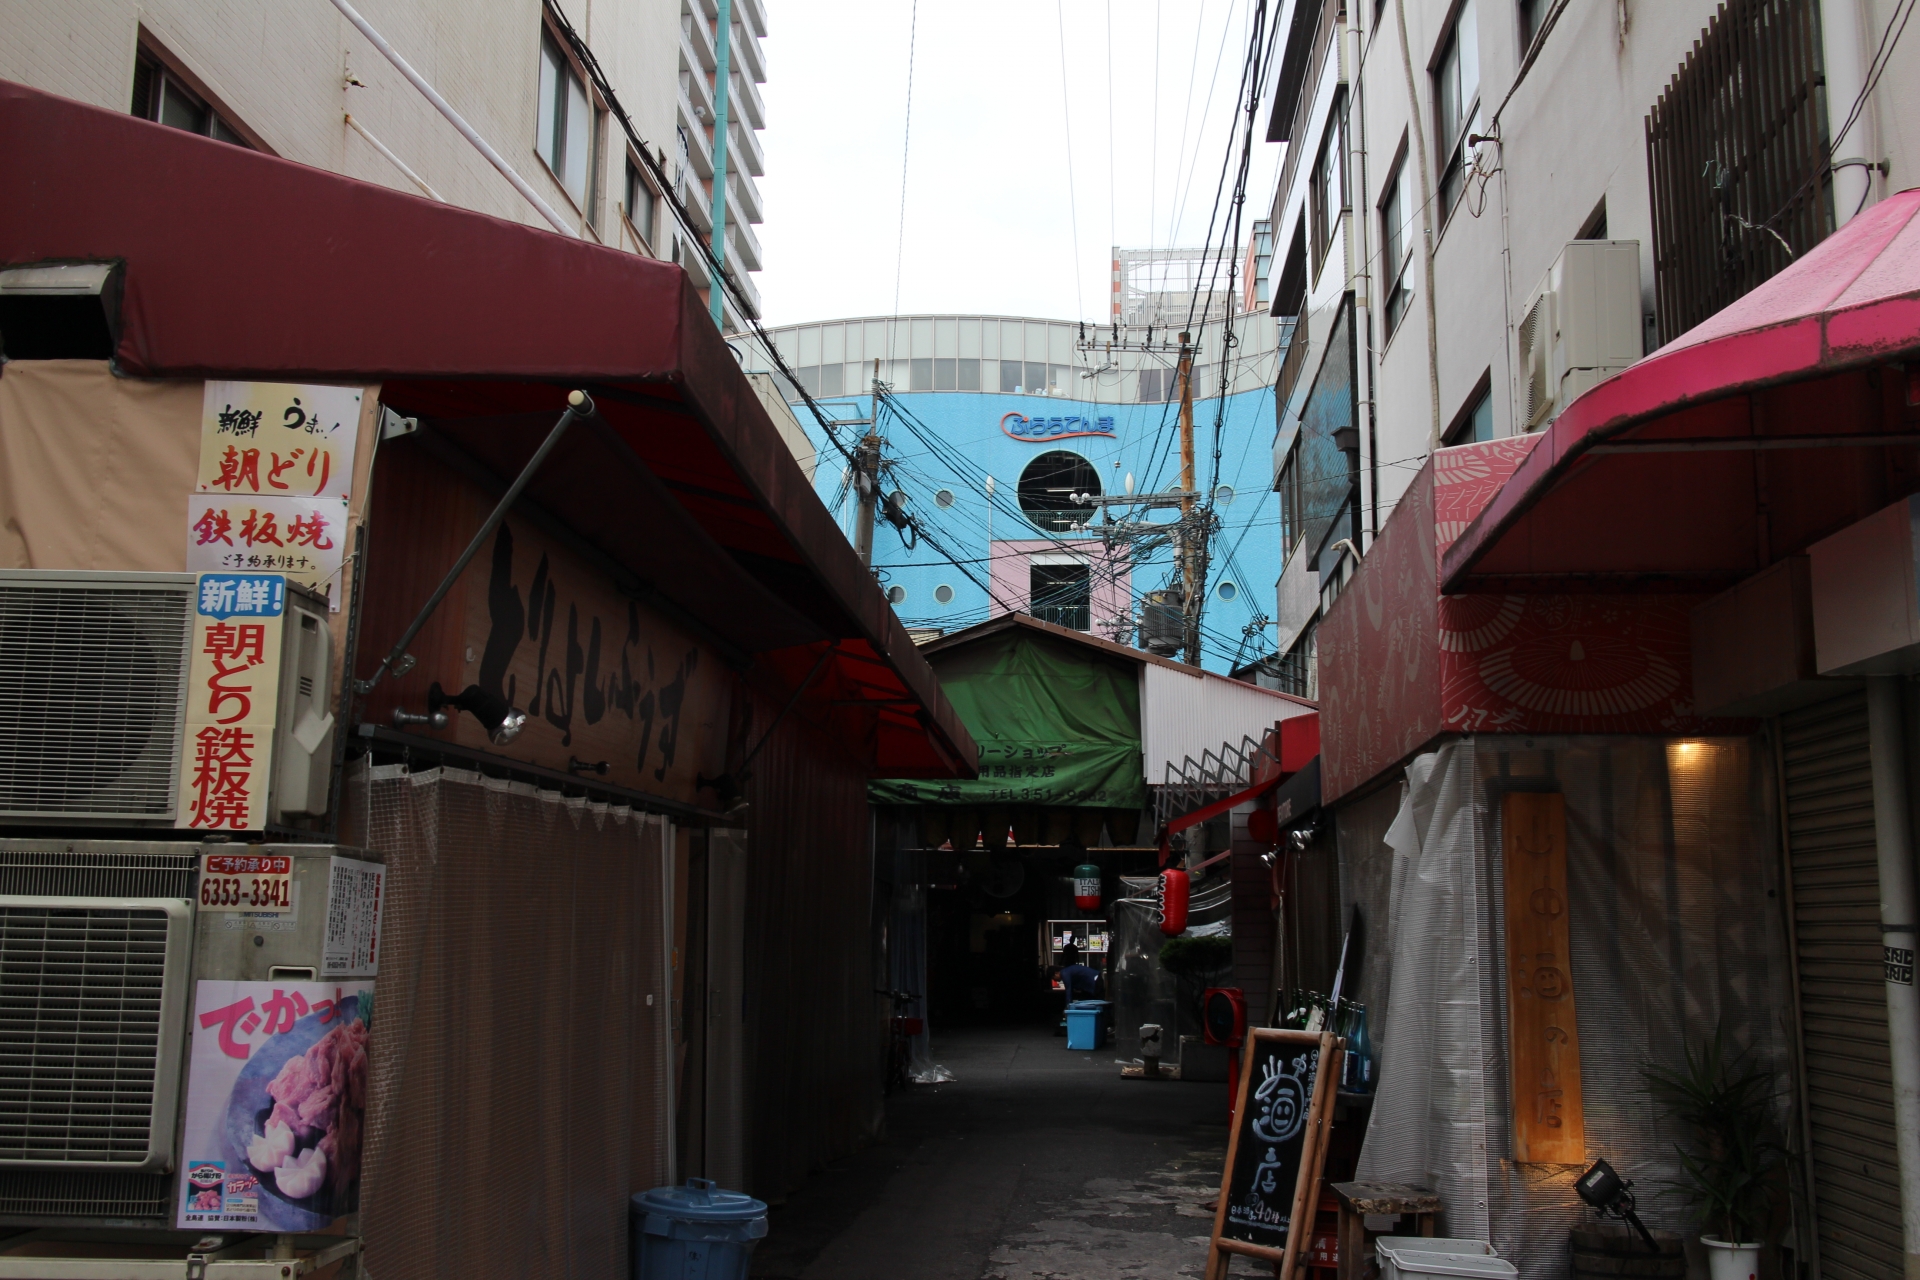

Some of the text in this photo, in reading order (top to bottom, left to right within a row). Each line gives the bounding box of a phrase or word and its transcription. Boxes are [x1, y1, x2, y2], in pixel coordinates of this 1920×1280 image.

[217, 404, 262, 438] 新鮮
[1010, 416, 1114, 435] ぷららてんま
[212, 445, 330, 496] 朝どり
[193, 508, 333, 550] 鉄板焼
[201, 579, 282, 612] 新鮮!
[210, 857, 285, 872] ご予約承り中
[201, 878, 289, 906] 6353-3341
